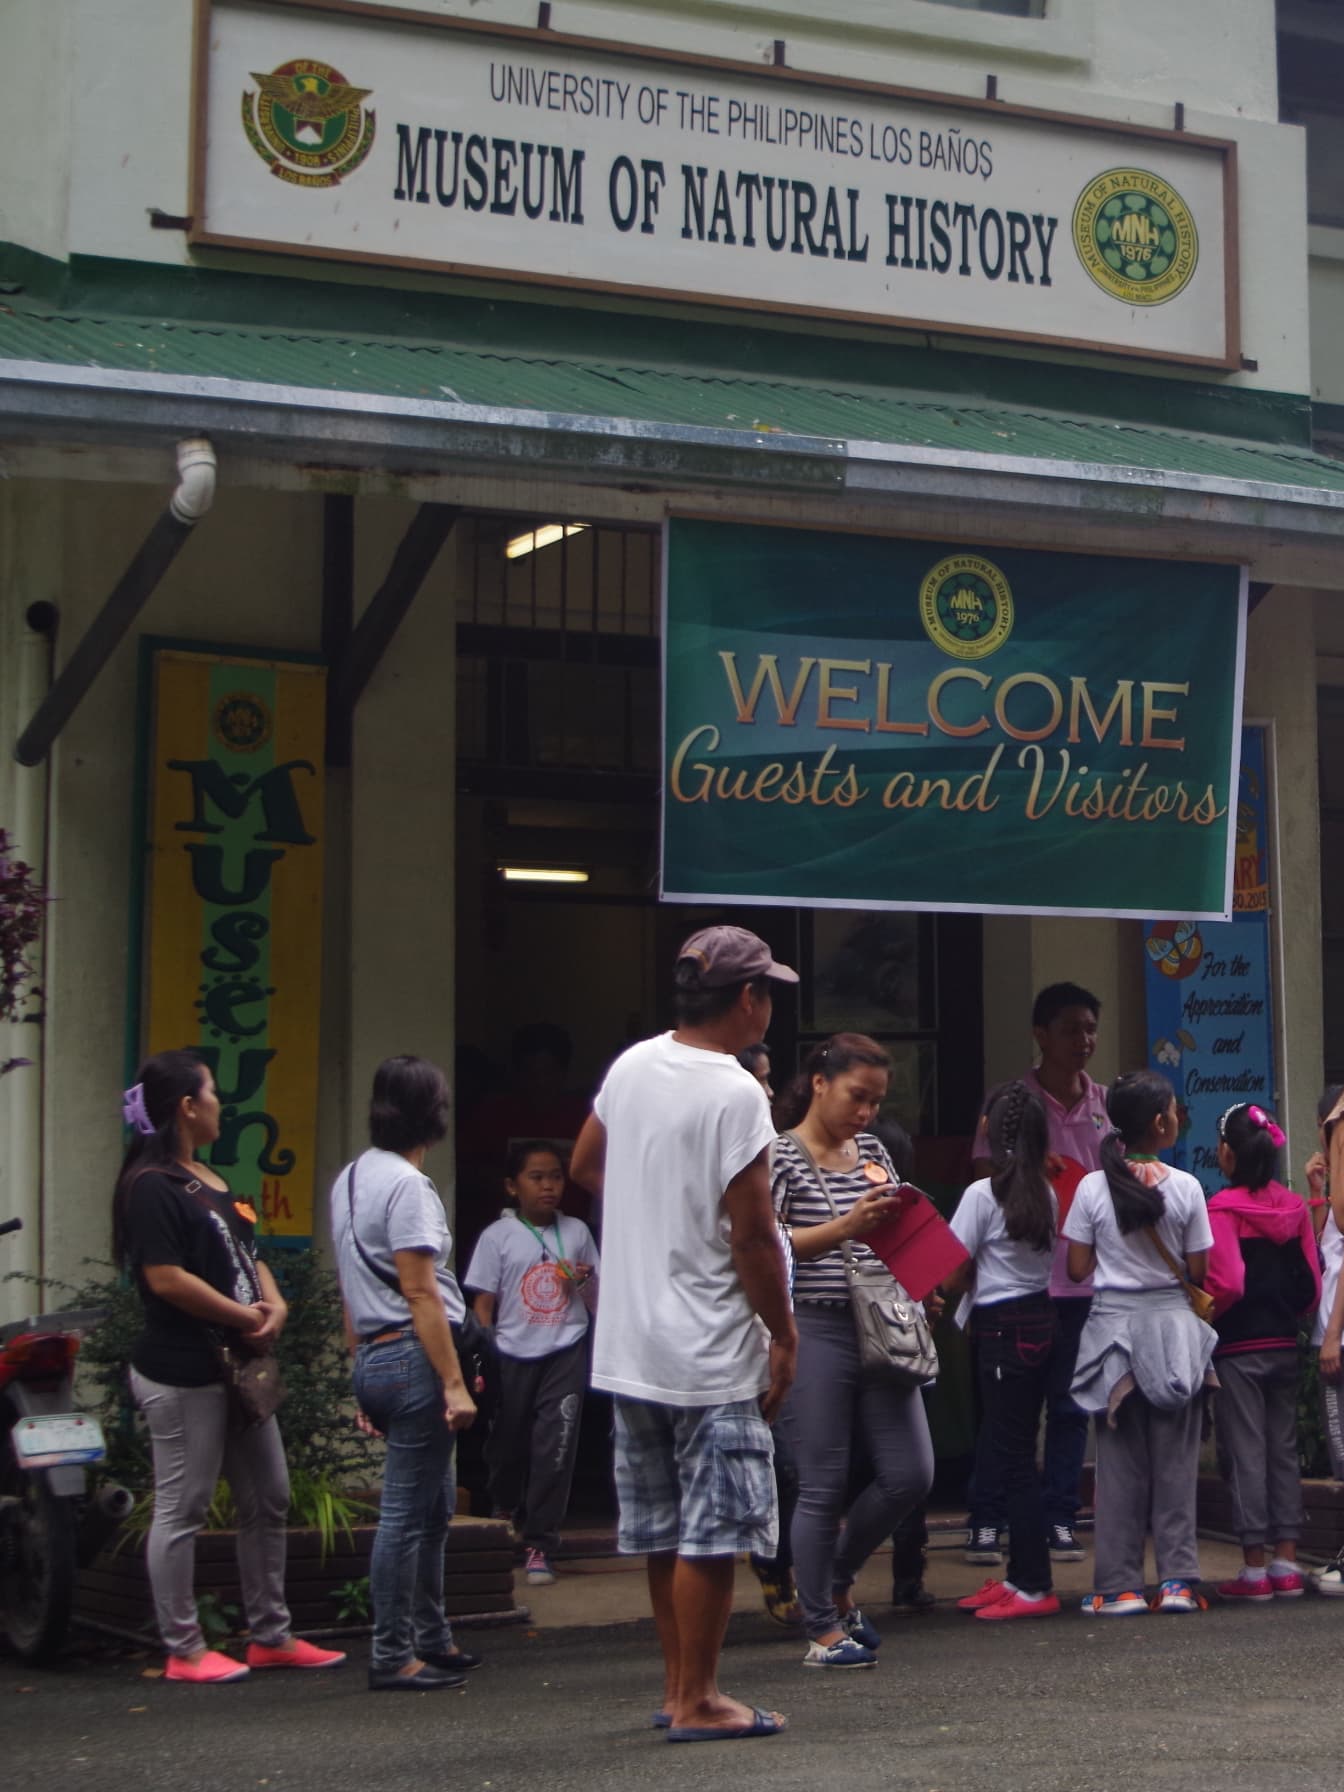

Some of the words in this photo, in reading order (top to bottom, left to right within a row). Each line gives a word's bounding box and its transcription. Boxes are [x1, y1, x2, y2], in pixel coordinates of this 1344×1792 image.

[489, 63, 631, 121] UNIVERSITY
[638, 86, 669, 124] OF
[676, 92, 720, 134] THE
[728, 100, 863, 157] PHILIPPINES
[869, 125, 912, 165] LOS
[919, 127, 993, 180] BAÑOS
[394, 123, 585, 225] MUSEUM
[609, 156, 665, 233] OF
[681, 165, 869, 263] NATURAL
[885, 194, 1058, 286] HISTORY
[1080, 201, 1100, 268] MUSEUM
[1093, 184, 1107, 199] OF
[1110, 175, 1175, 210] NATURAL
[1174, 212, 1192, 279] HISTORY
[1112, 213, 1159, 245] MNH
[1120, 245, 1153, 261] 1976
[925, 578, 938, 625] MUSEUM
[938, 564, 951, 577] OF
[953, 559, 997, 581] NATURAL
[995, 582, 1009, 632] HISTORY
[950, 588, 983, 611] MNH
[955, 611, 980, 624] 1976
[718, 651, 1190, 751] WELCOME
[670, 724, 870, 809] Guests
[882, 743, 1004, 813] and
[1017, 744, 1227, 825] Visitors
[1201, 951, 1226, 979] For
[1228, 952, 1251, 977] the
[1182, 991, 1265, 1025] Appreciation
[1212, 1031, 1244, 1055] and
[1185, 1067, 1266, 1097] Conservation
